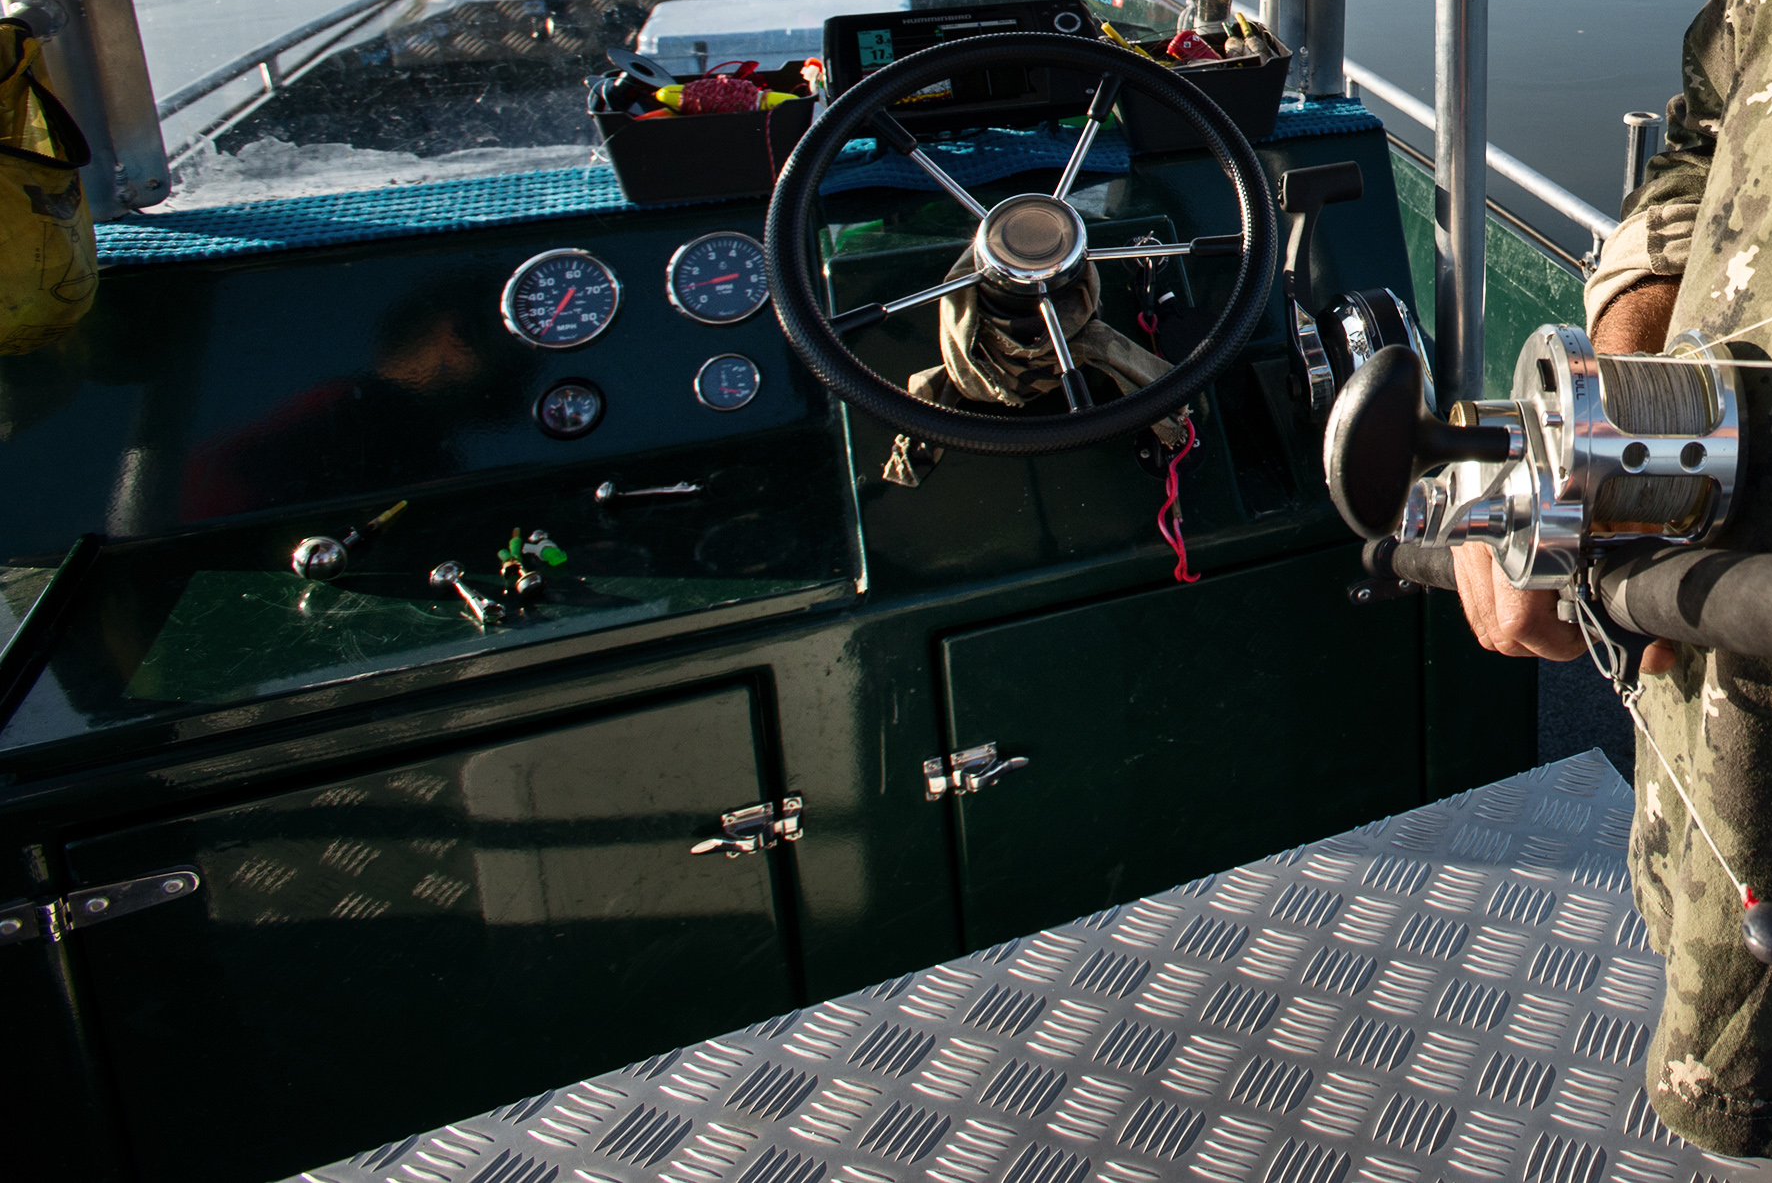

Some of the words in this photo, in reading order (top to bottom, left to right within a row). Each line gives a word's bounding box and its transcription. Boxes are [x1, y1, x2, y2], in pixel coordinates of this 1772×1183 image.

[902, 13, 972, 24] HUMMINBIRD
[708, 251, 716, 261] 3
[728, 249, 737, 258] 4
[745, 260, 753, 269] 5
[565, 269, 581, 279] 60
[691, 266, 700, 276] 2
[538, 277, 555, 287] 50
[750, 274, 759, 283] 6
[585, 285, 601, 295] 70
[745, 288, 753, 298] 7
[527, 292, 545, 301] 40
[699, 294, 708, 303] 0
[528, 307, 545, 317] 30
[580, 312, 597, 322] 80
[556, 323, 577, 332] MPH
[1574, 372, 1586, 401] FULL
